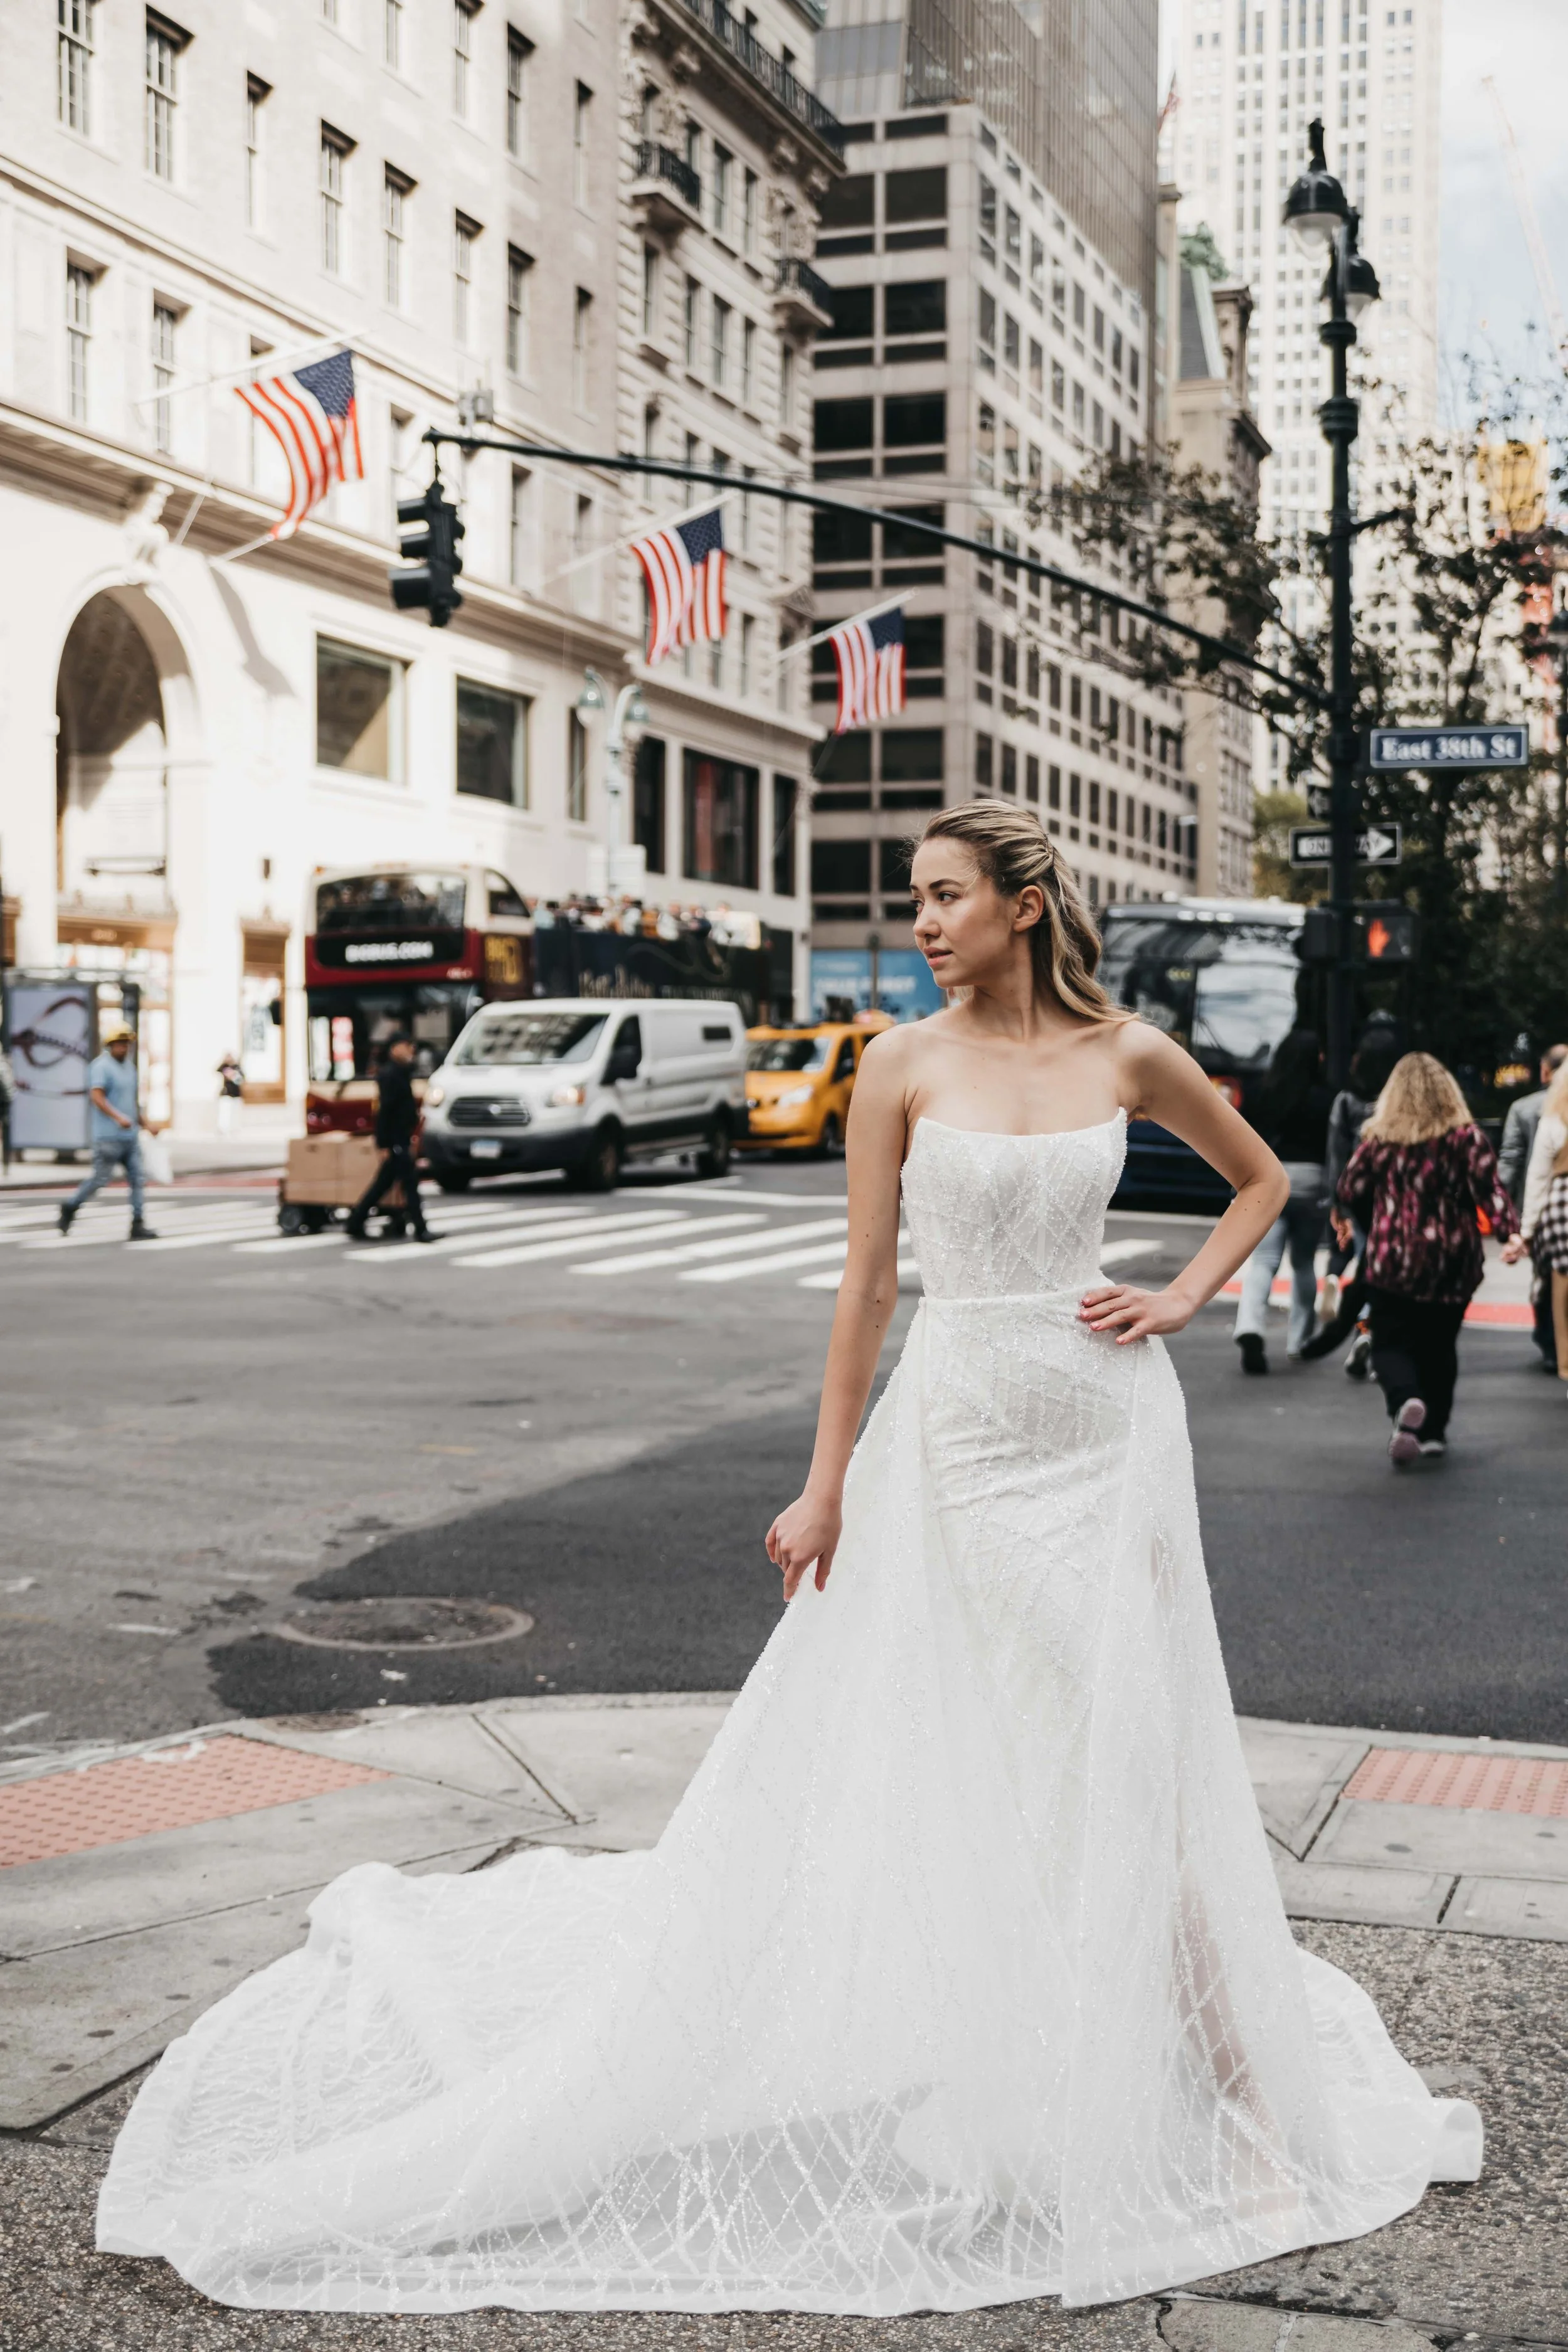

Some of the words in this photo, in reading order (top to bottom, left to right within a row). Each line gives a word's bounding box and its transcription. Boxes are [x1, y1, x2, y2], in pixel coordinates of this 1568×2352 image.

[1382, 736, 1431, 760] East
[1436, 736, 1486, 760] 38th
[1490, 733, 1517, 758] St
